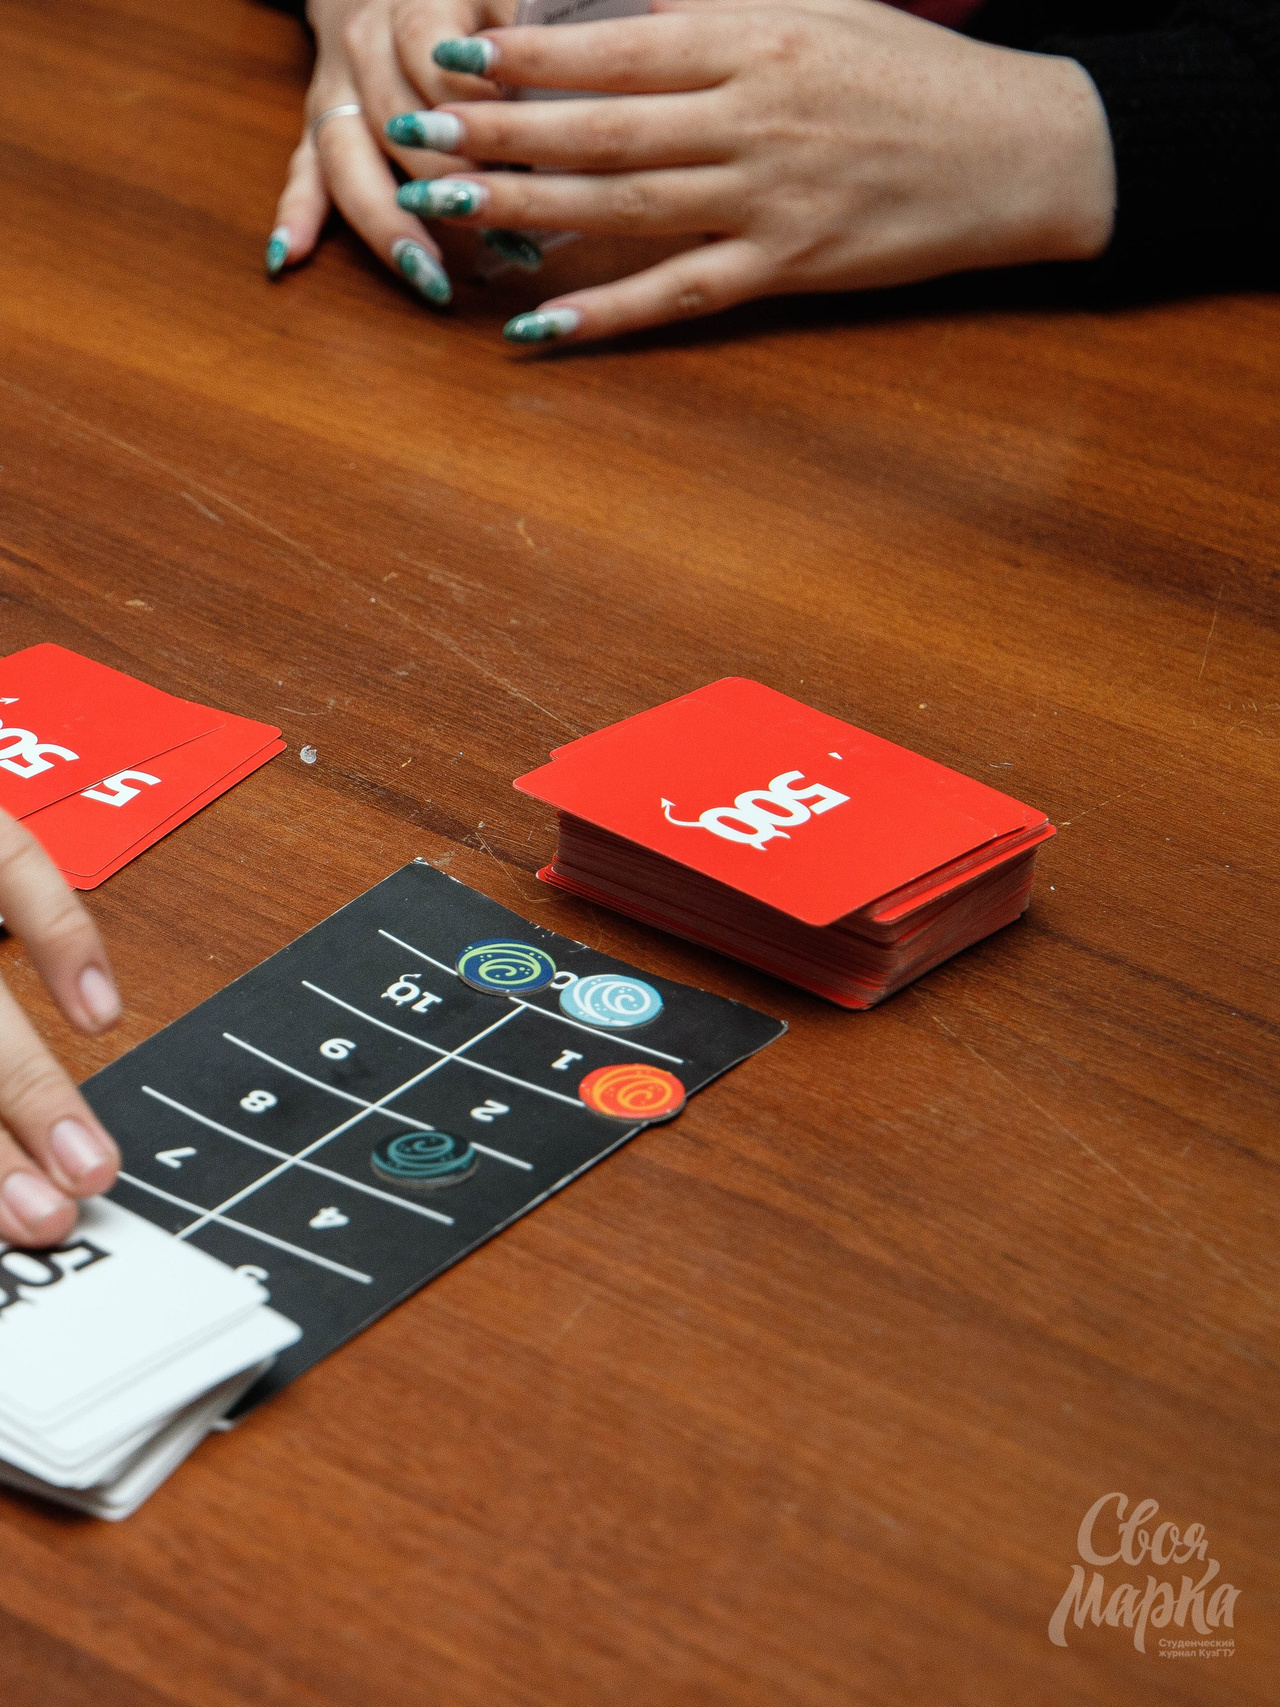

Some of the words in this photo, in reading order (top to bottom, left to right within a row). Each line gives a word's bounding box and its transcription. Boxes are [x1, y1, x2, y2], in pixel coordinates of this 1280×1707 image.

[664, 770, 851, 851] 500
[381, 975, 443, 1013] 10
[320, 1037, 357, 1060] 9
[551, 1049, 583, 1071] 1
[240, 1089, 278, 1113] 8
[470, 1100, 510, 1122] 2
[155, 1146, 198, 1169] 7
[309, 1206, 350, 1230] 4
